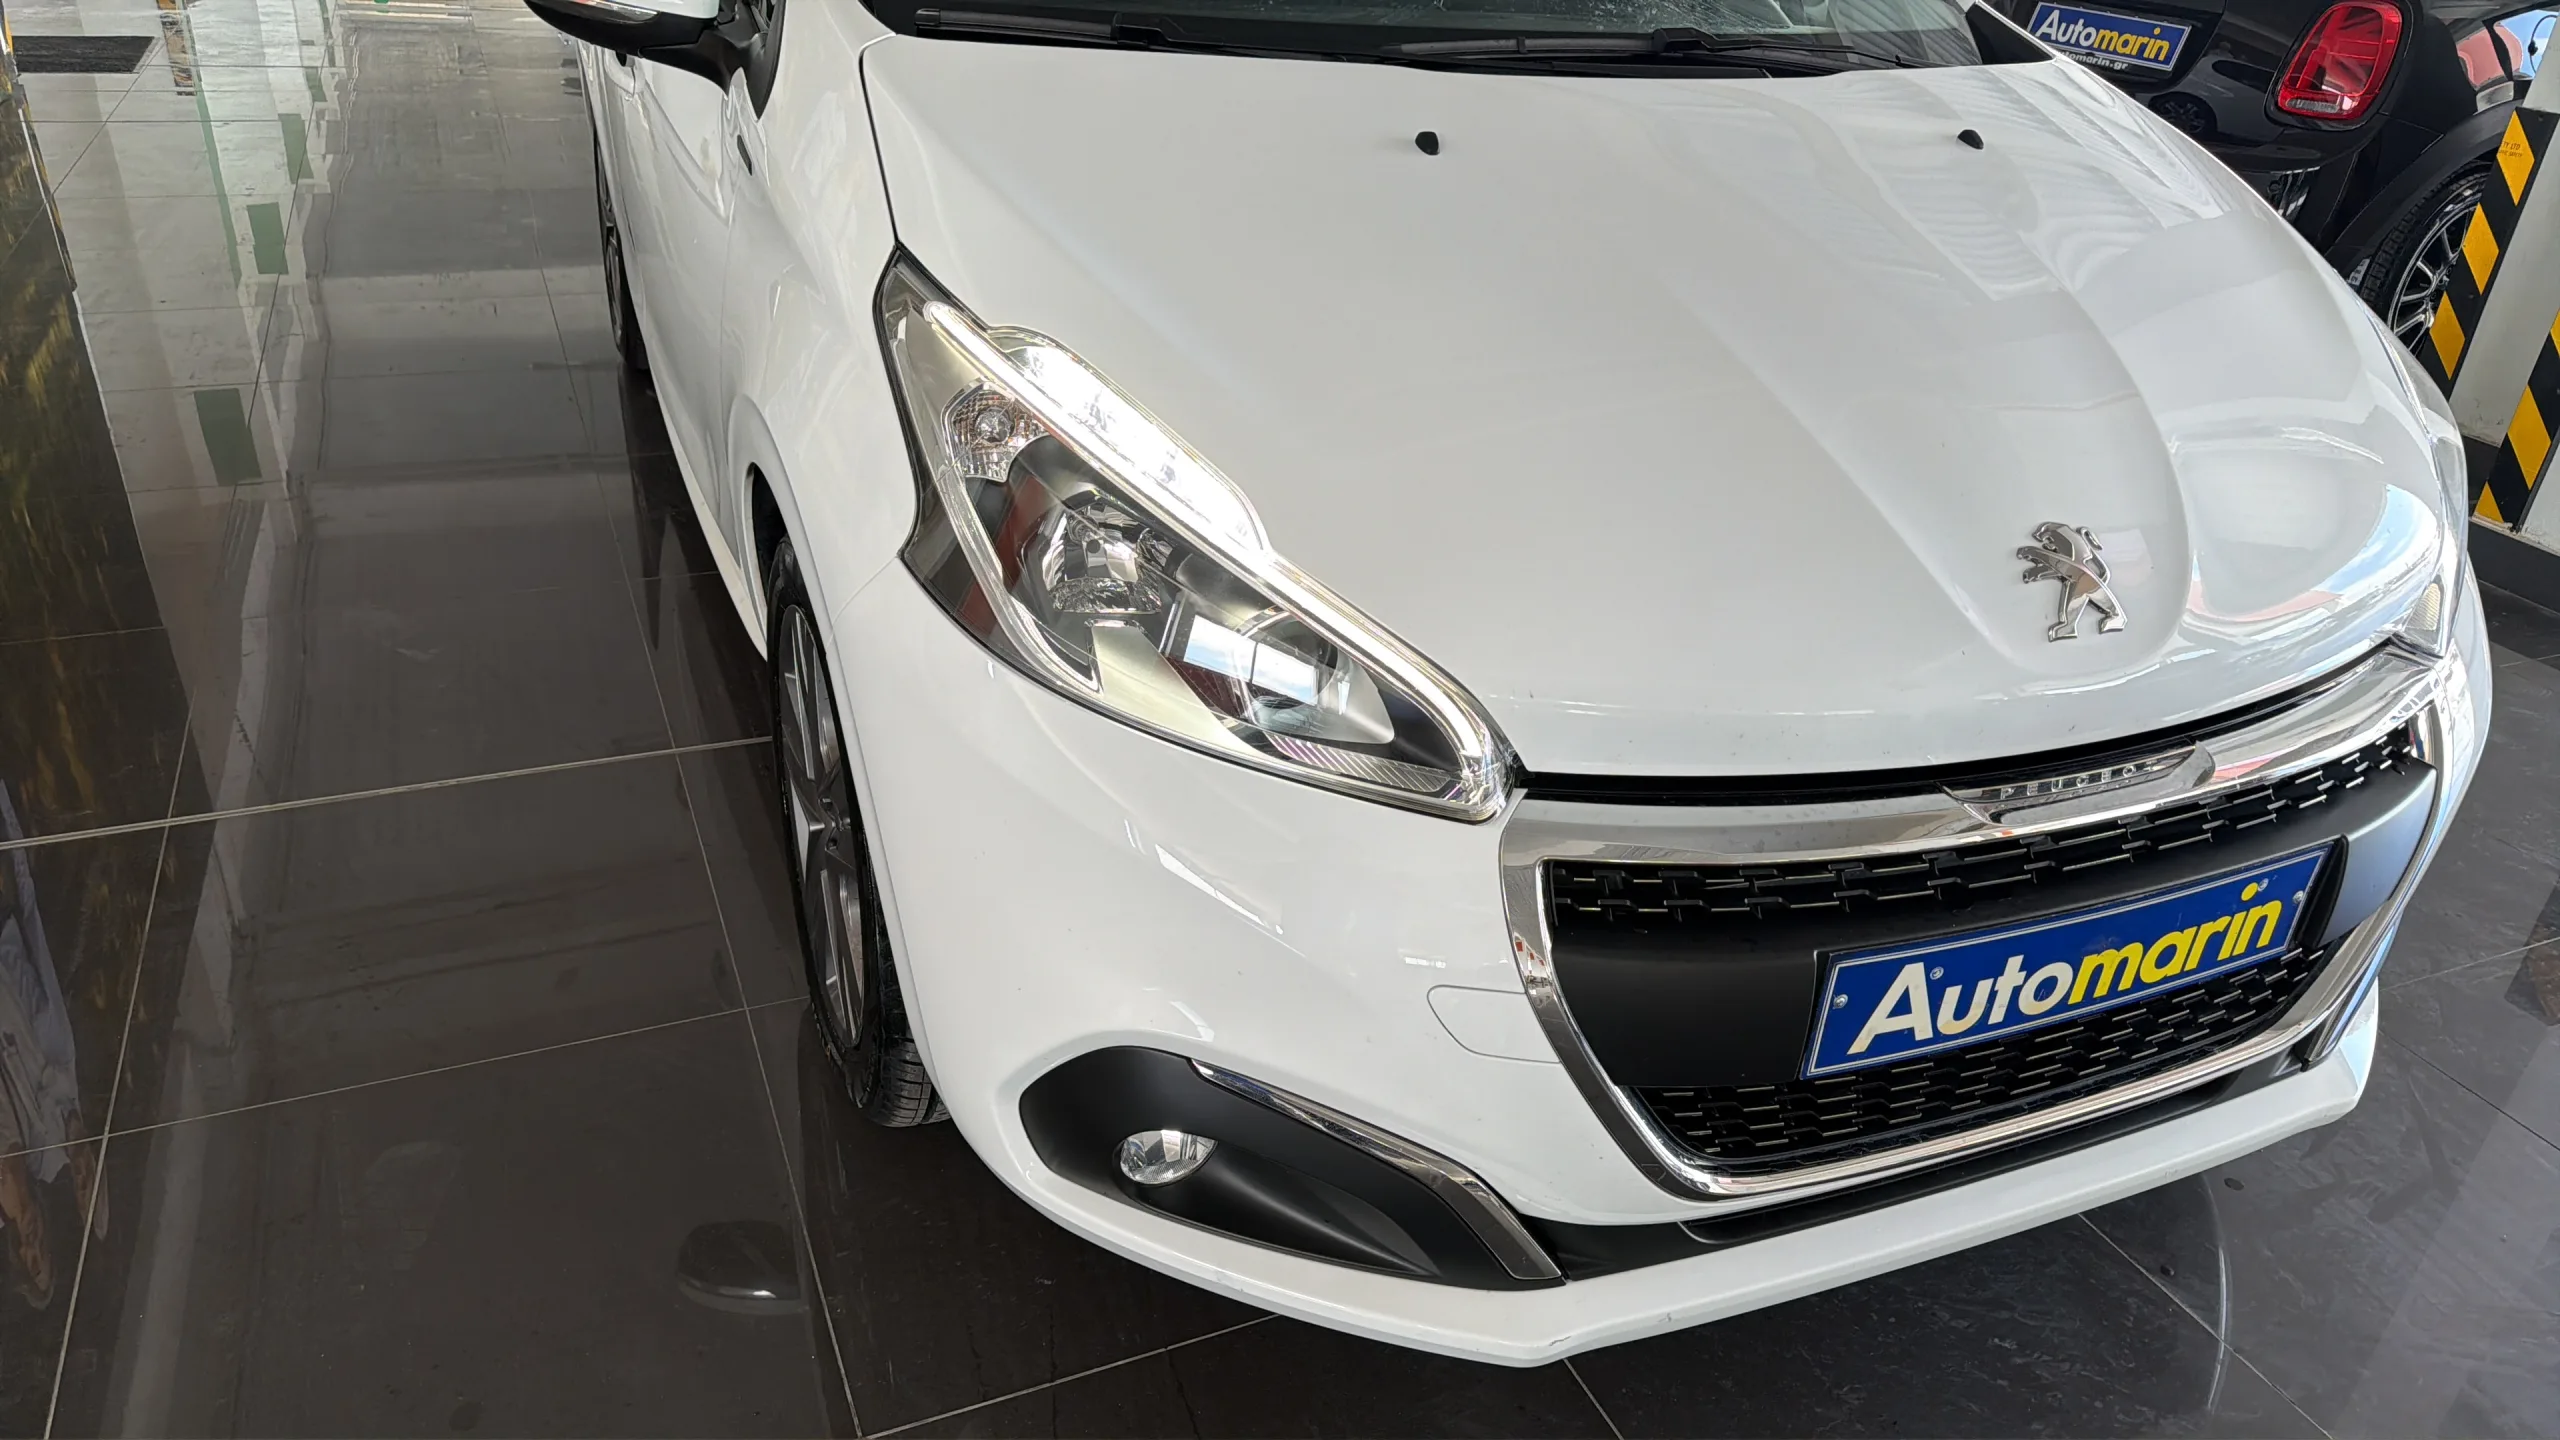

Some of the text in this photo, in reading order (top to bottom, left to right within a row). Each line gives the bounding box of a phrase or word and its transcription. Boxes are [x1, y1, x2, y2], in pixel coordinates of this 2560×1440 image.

[2035, 9, 2170, 62] Automarin
[2058, 51, 2129, 71] tomarin.gr
[1846, 882, 2284, 1056] Automarin
